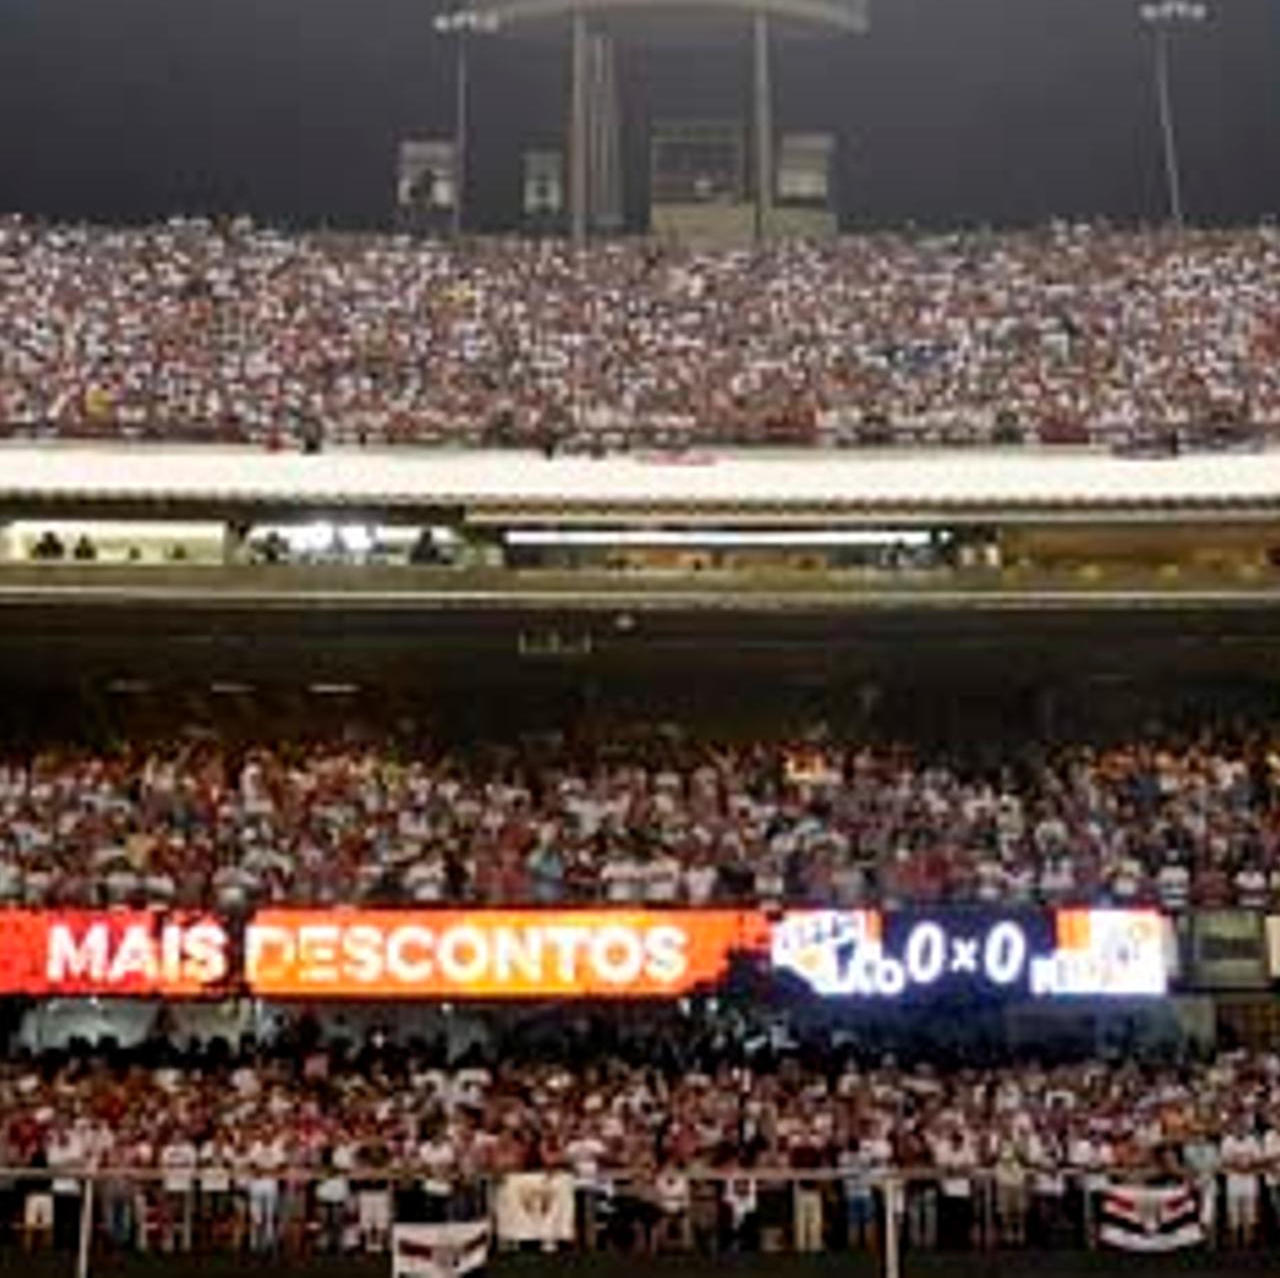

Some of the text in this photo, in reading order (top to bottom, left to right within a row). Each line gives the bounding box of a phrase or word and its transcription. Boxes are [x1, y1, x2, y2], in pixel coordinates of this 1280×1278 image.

[47, 924, 688, 983] MAIS DESCONTOS
[904, 922, 945, 983] 0
[984, 922, 1025, 983] 0
